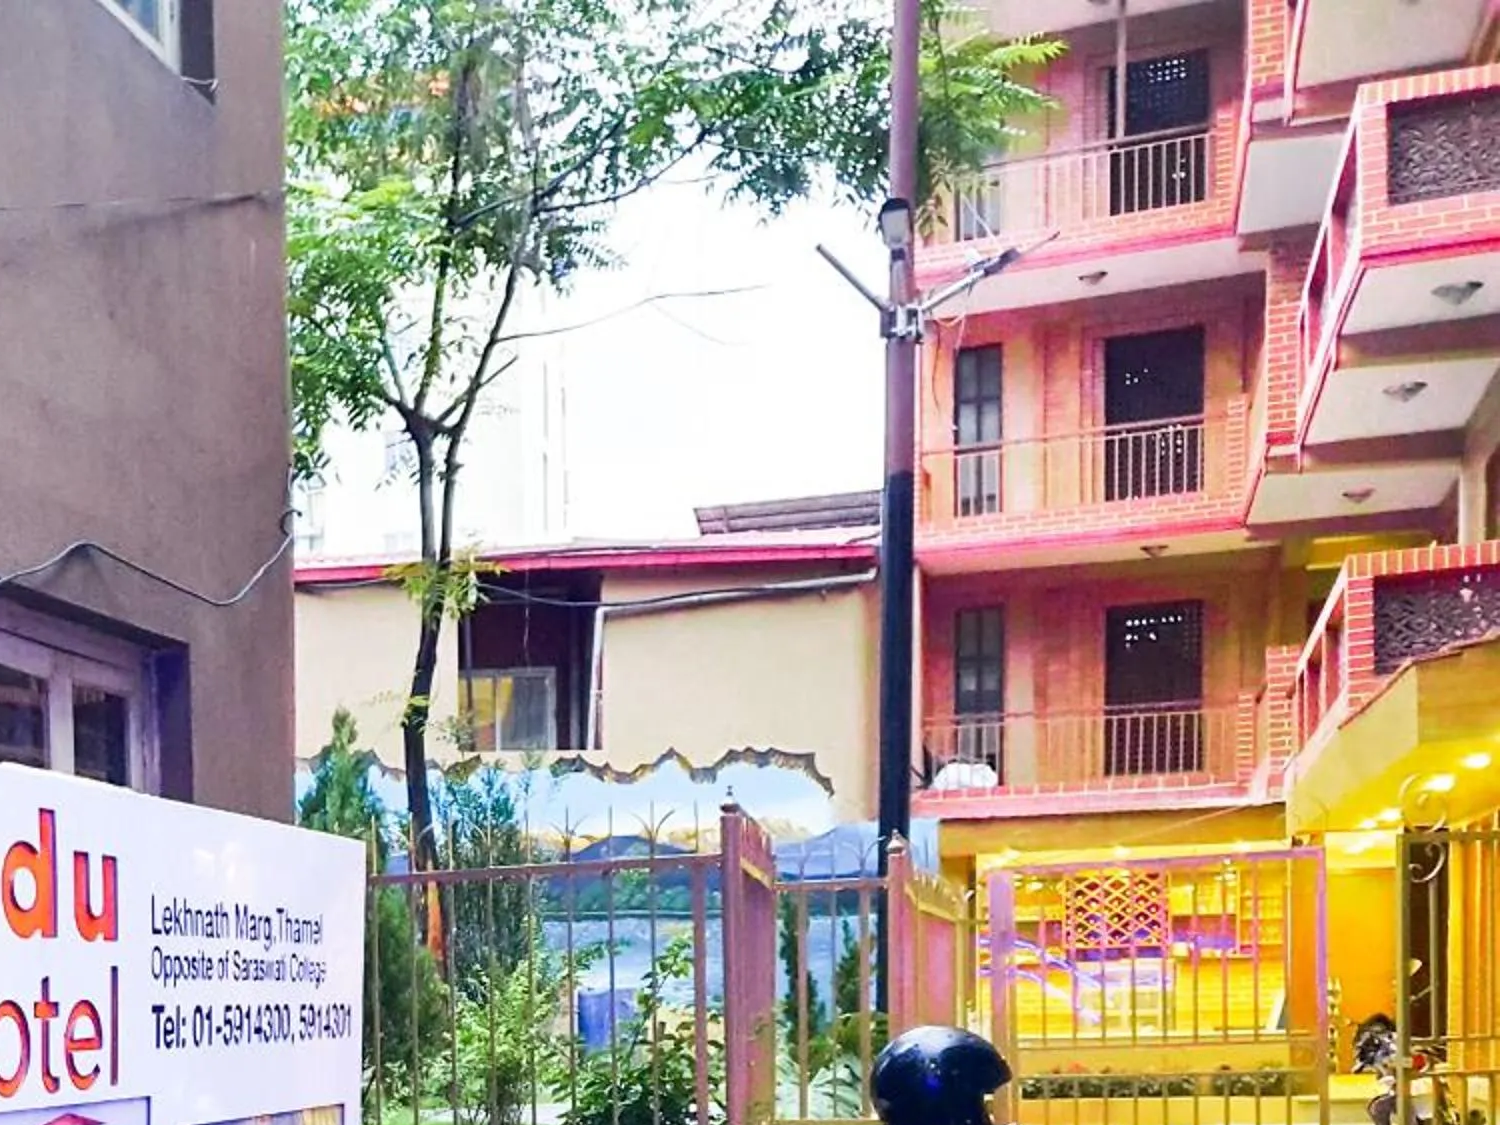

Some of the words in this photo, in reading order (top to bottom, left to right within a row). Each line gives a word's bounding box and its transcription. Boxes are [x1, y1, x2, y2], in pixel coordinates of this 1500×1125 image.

[150, 893, 230, 939] Lekhnath
[150, 945, 213, 988] Opposite
[217, 949, 230, 980] of
[151, 1004, 187, 1049] Tel:
[192, 1003, 295, 1047] 01-5914300,
